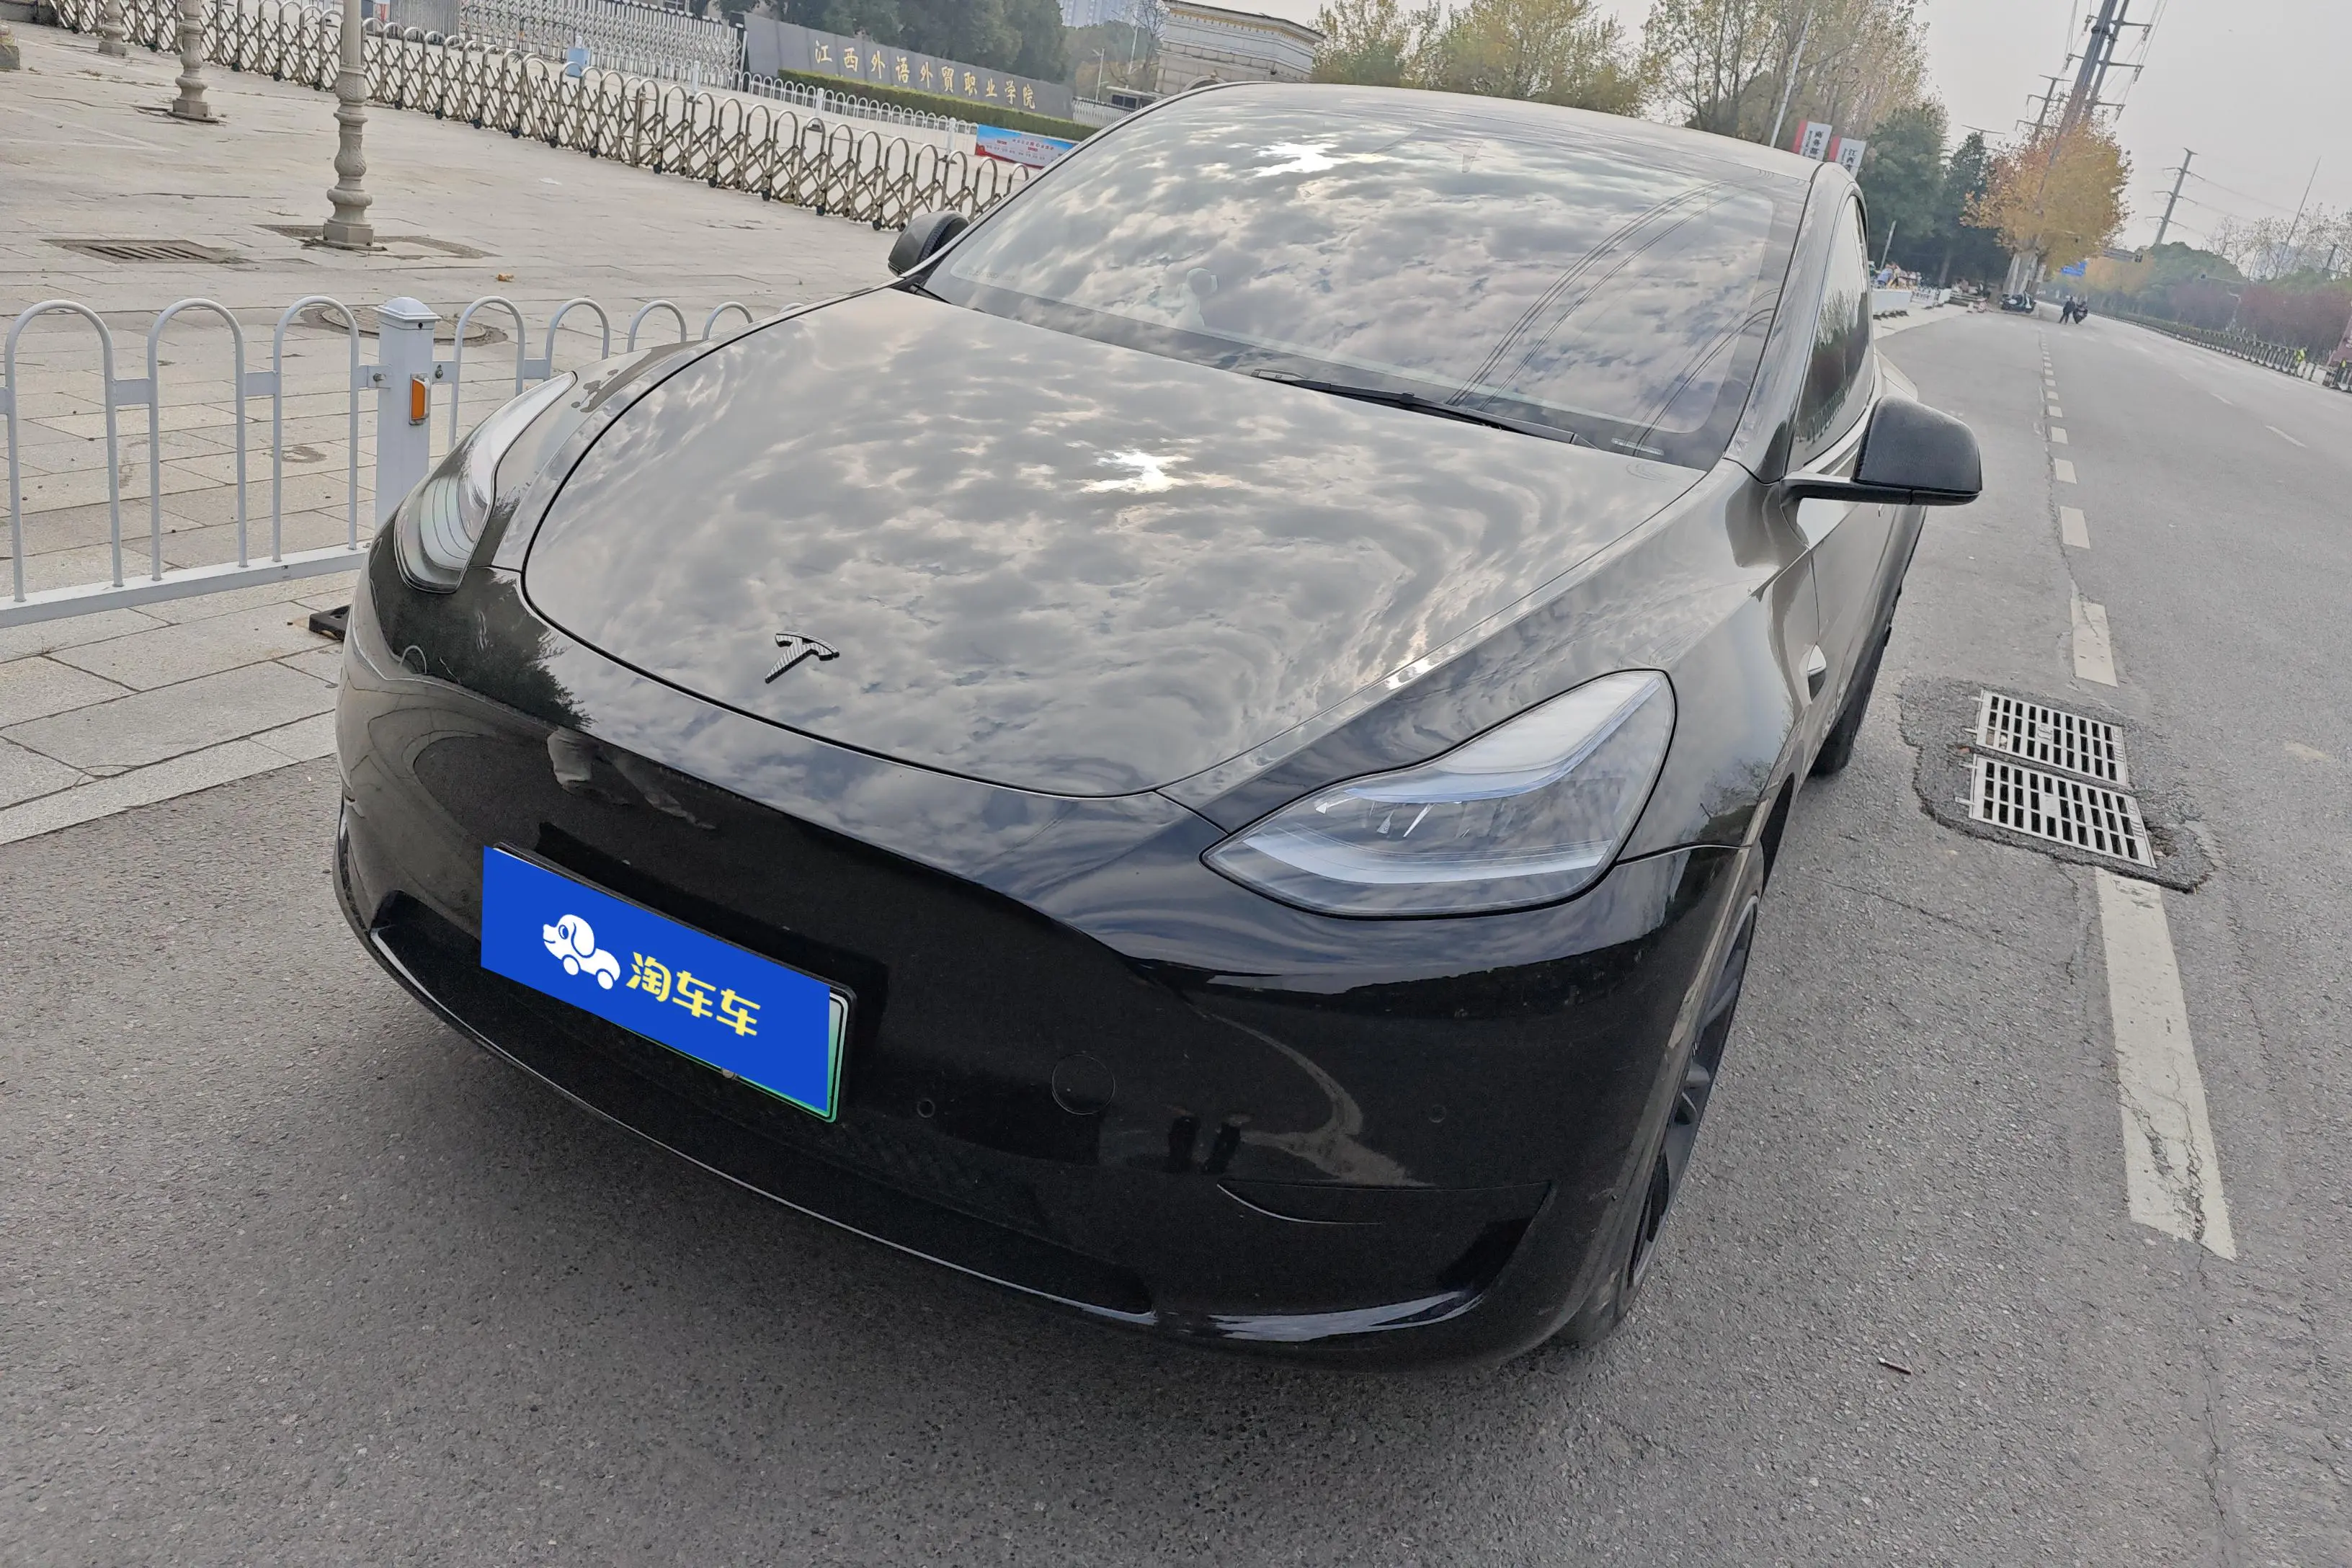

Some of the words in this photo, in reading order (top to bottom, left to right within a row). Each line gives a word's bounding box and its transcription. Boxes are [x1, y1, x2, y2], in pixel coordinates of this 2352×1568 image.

[815, 40, 1035, 109] 江西外语外贸职业学院
